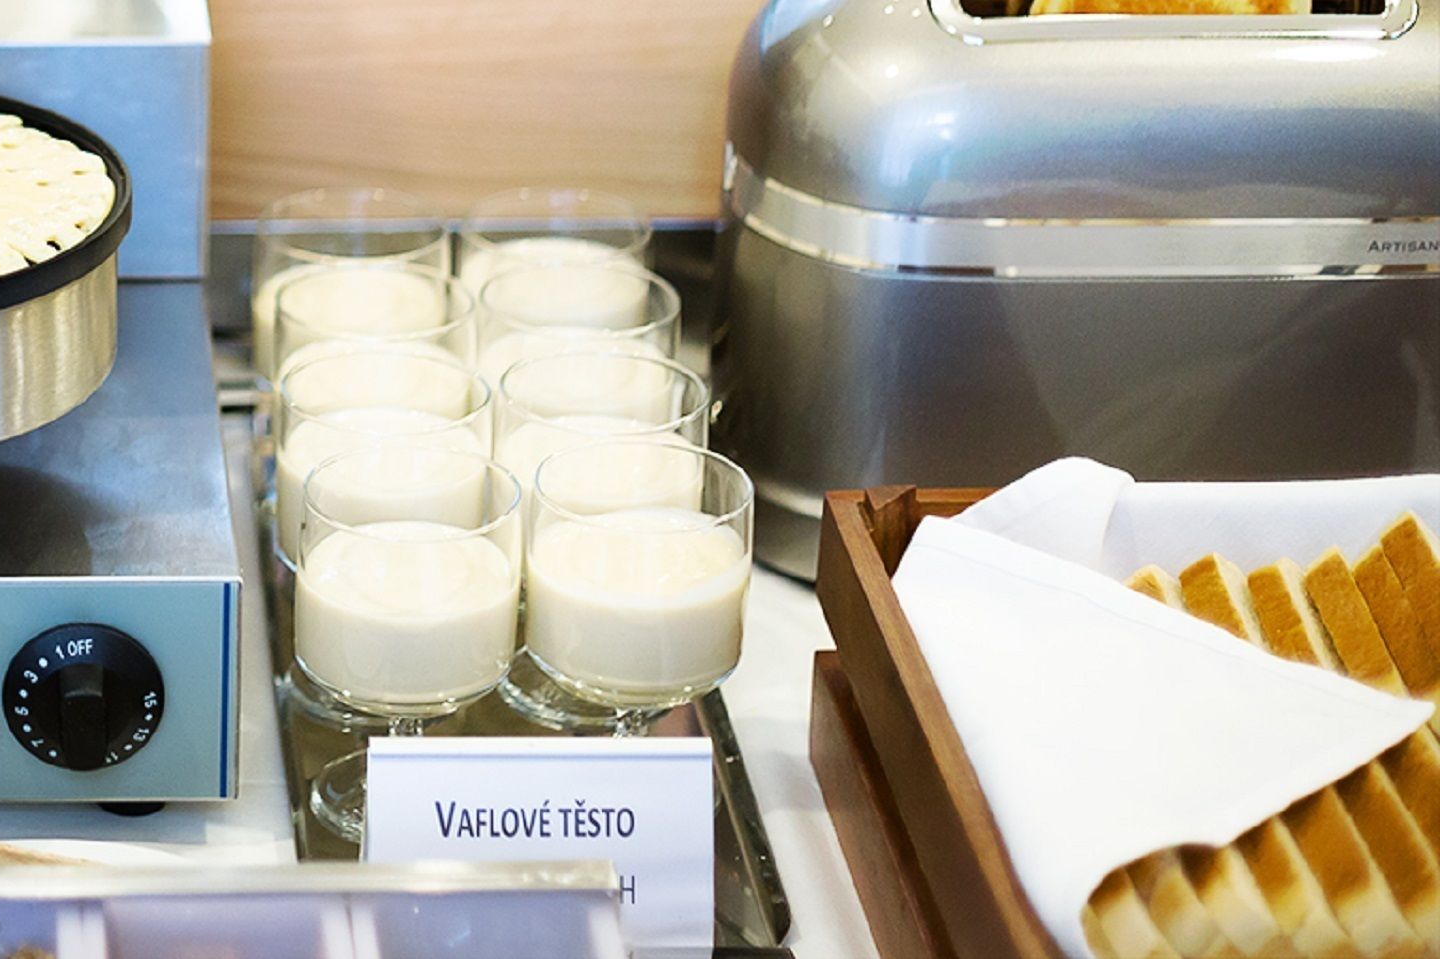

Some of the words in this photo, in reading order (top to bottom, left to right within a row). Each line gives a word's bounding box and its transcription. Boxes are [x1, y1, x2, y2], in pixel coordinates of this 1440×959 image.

[67, 639, 94, 657] OFF
[23, 669, 39, 684] 3
[144, 691, 158, 709] 15
[14, 706, 29, 716] 5
[133, 727, 150, 742] 13
[434, 800, 552, 839] VAFLOVÉ
[557, 800, 636, 839] TĚSTO
